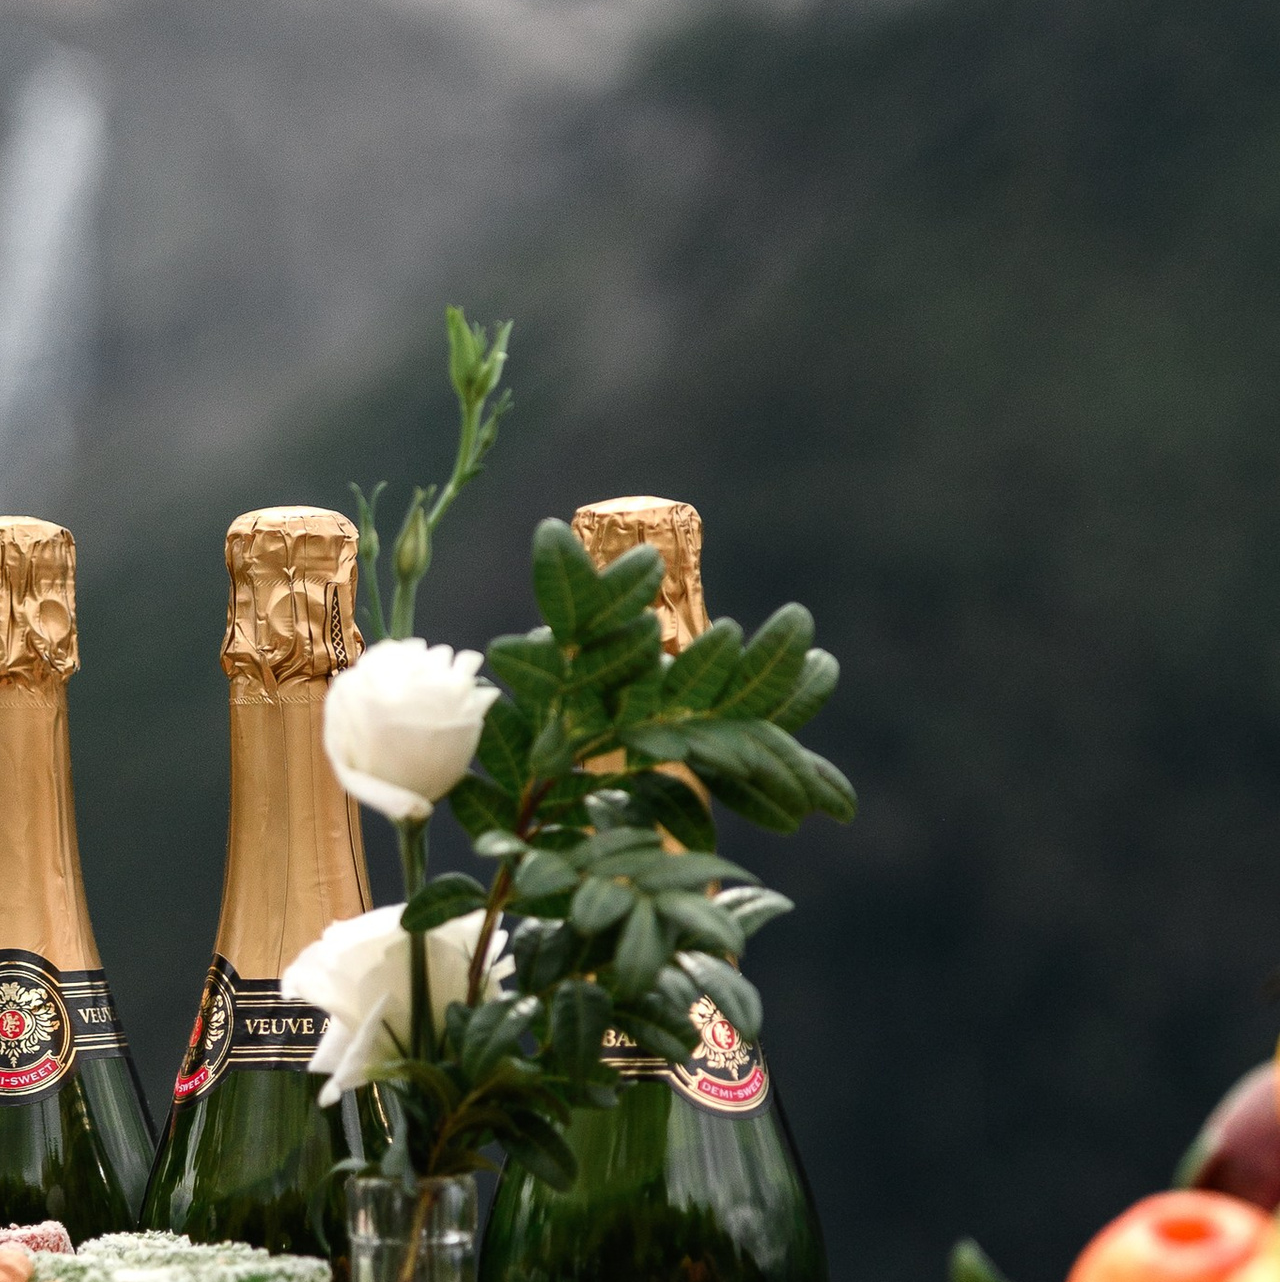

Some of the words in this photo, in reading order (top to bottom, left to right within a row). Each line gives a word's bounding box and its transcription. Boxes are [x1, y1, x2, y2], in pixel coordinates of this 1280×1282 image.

[77, 1007, 116, 1024] VEUV
[245, 1017, 315, 1035] VEUVE
[702, 1071, 763, 1099] DEMI-SWEET
